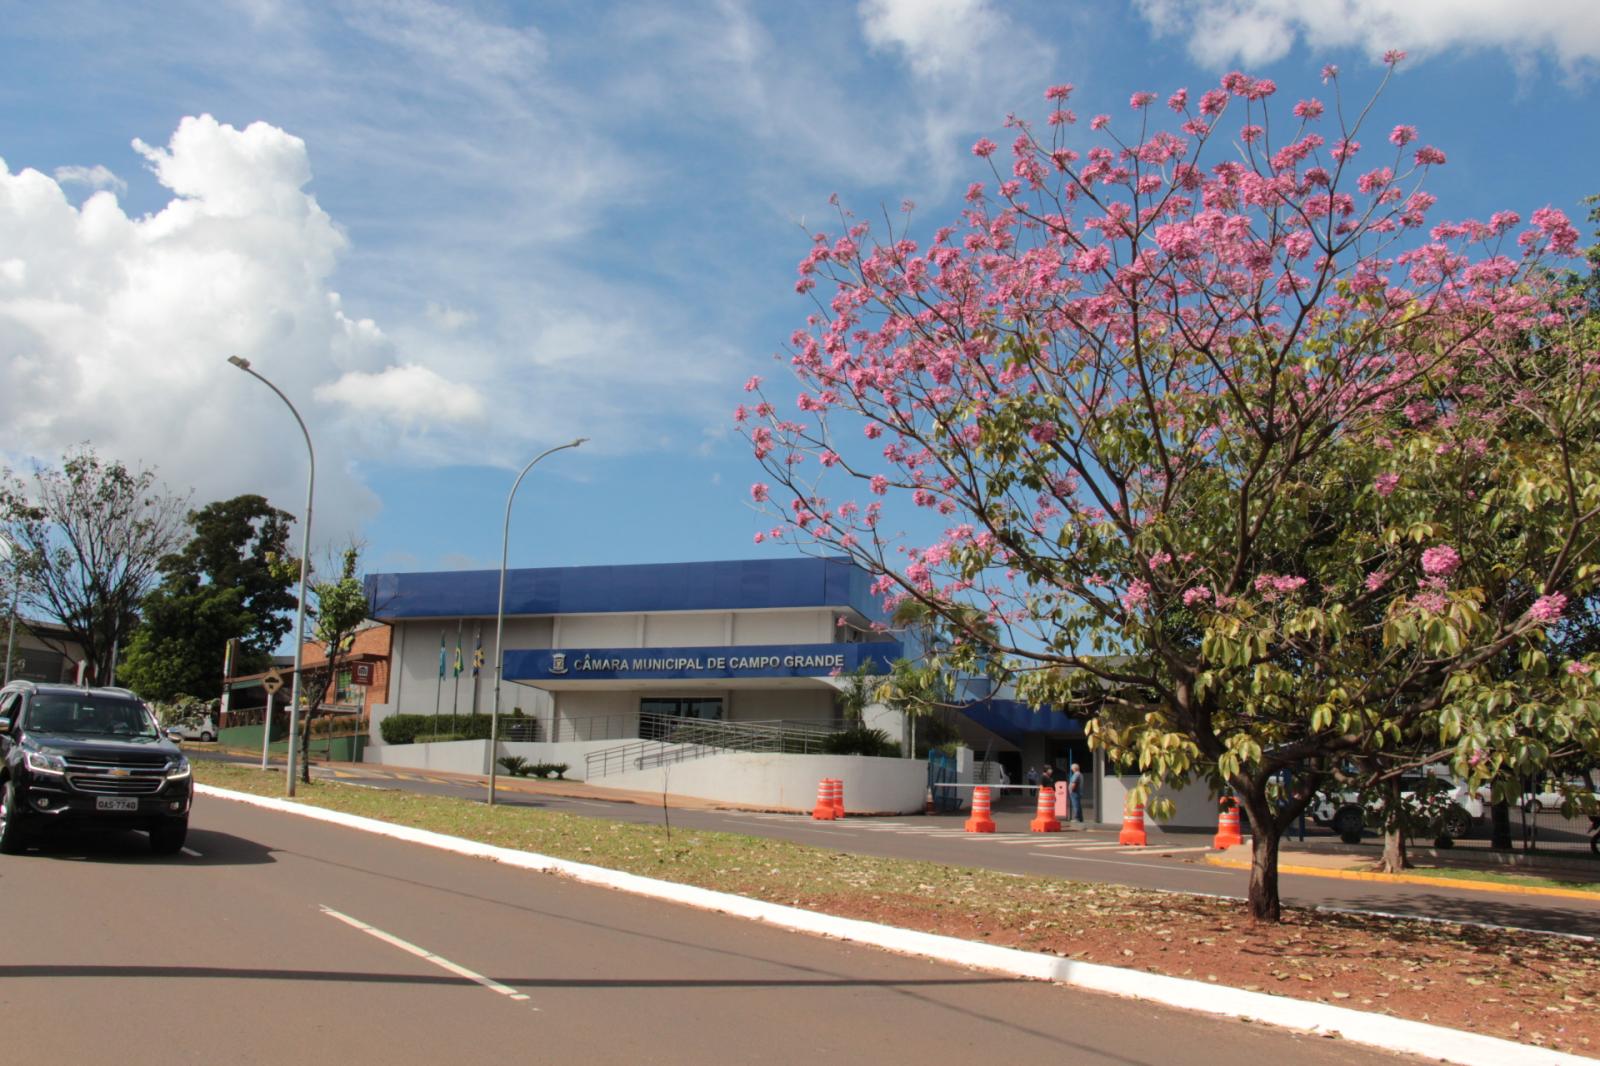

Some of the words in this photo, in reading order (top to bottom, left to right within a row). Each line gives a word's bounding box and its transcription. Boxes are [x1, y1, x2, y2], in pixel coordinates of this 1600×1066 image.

[574, 653, 629, 671] CÂMARA
[632, 658, 704, 671] MUNICIPAL
[707, 657, 725, 669] DE
[729, 656, 780, 669] CAMPO
[784, 655, 844, 667] GRANDE
